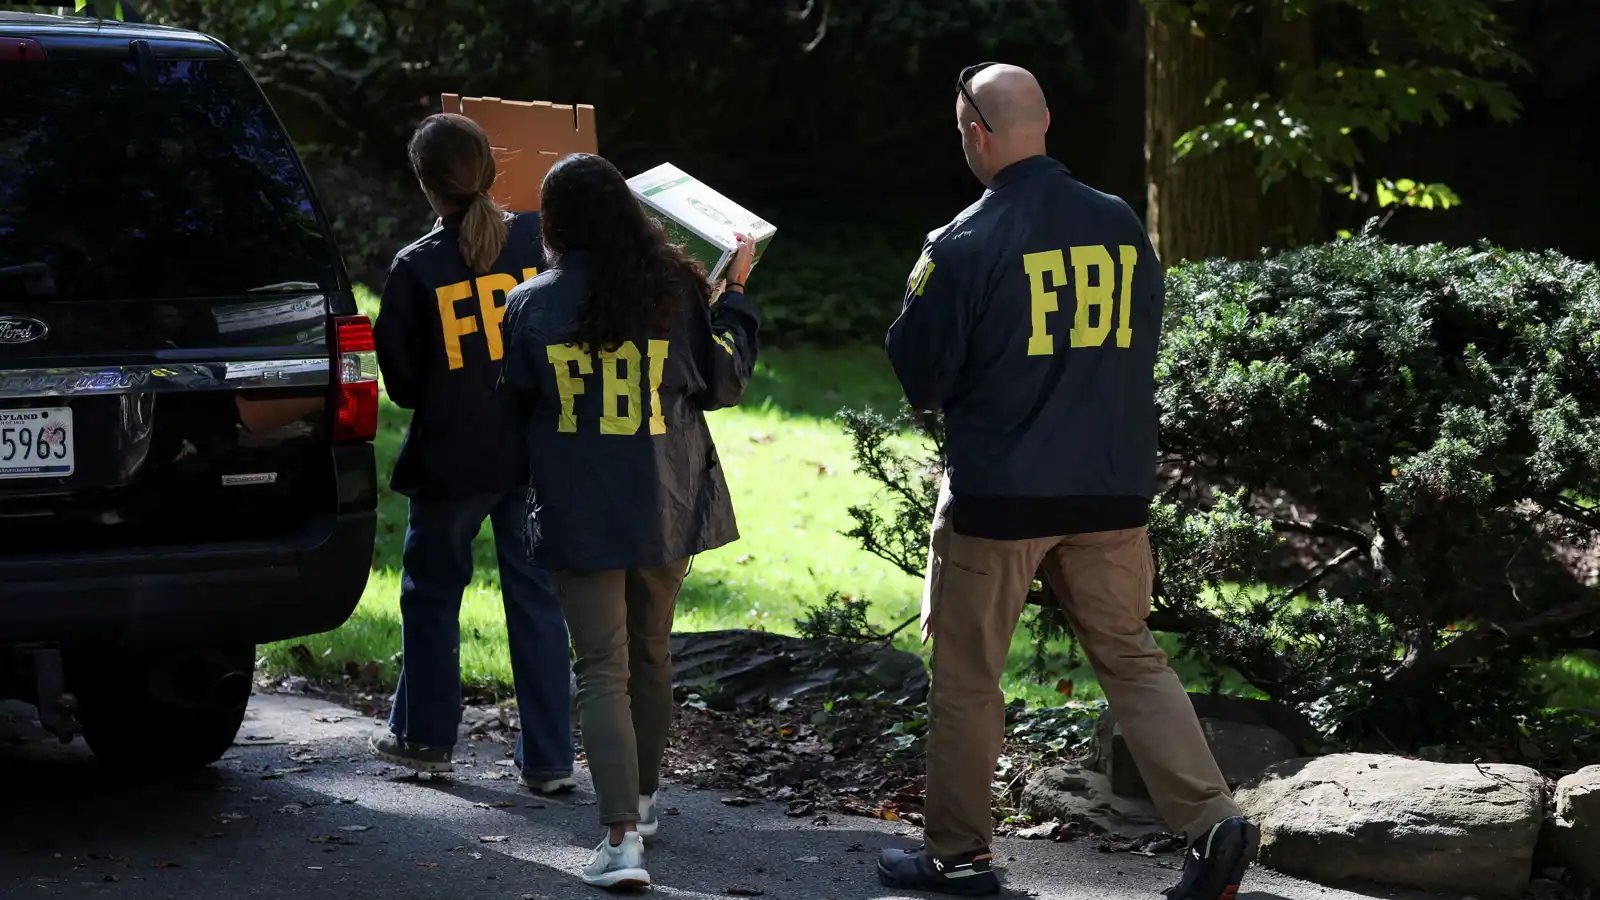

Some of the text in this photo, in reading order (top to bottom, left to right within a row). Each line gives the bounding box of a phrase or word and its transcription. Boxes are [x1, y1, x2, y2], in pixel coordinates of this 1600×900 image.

[435, 266, 540, 370] FB
[1023, 244, 1138, 356] FBI
[546, 339, 670, 435] FBI
[2, 427, 67, 461] 5963
